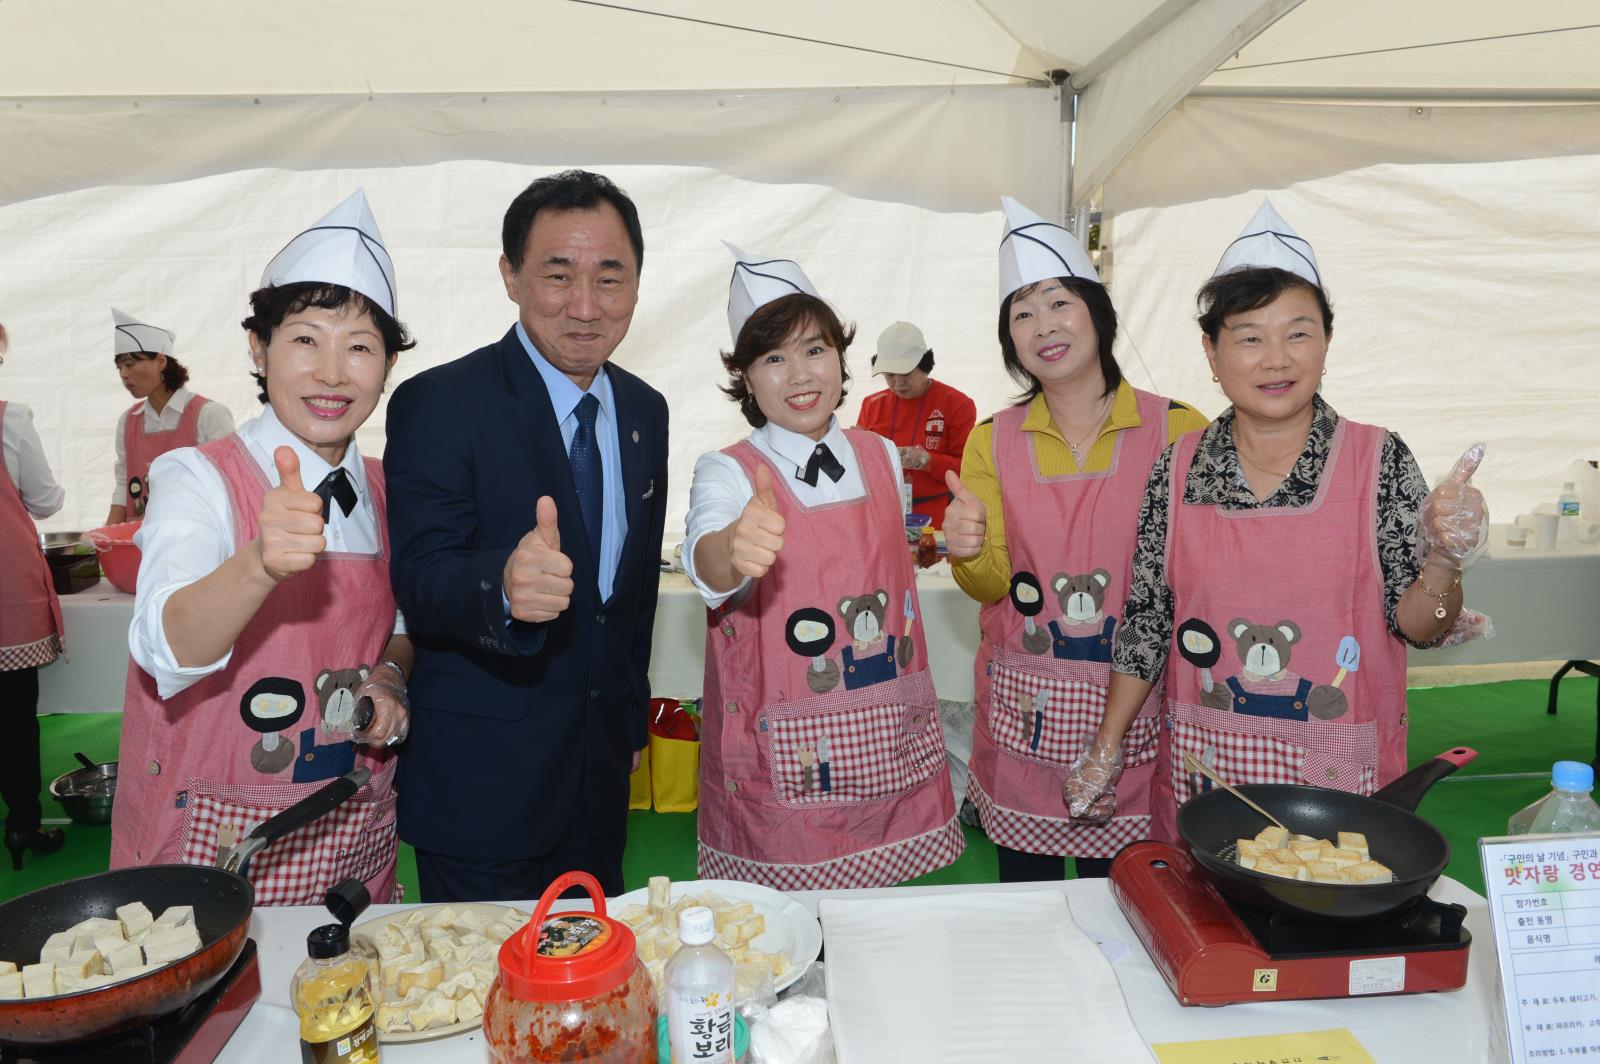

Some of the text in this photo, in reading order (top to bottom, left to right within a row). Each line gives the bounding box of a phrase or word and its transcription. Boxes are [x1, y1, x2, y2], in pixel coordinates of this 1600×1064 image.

[1537, 852, 1545, 862] 날
[1572, 849, 1598, 860] 구민과
[1504, 864, 1559, 885] 맛자랑
[1516, 898, 1548, 909] 참가번호
[1517, 916, 1534, 927] 출전
[1527, 933, 1551, 944] 음식명
[689, 1011, 731, 1040] 황금
[692, 1031, 731, 1058] 보리
